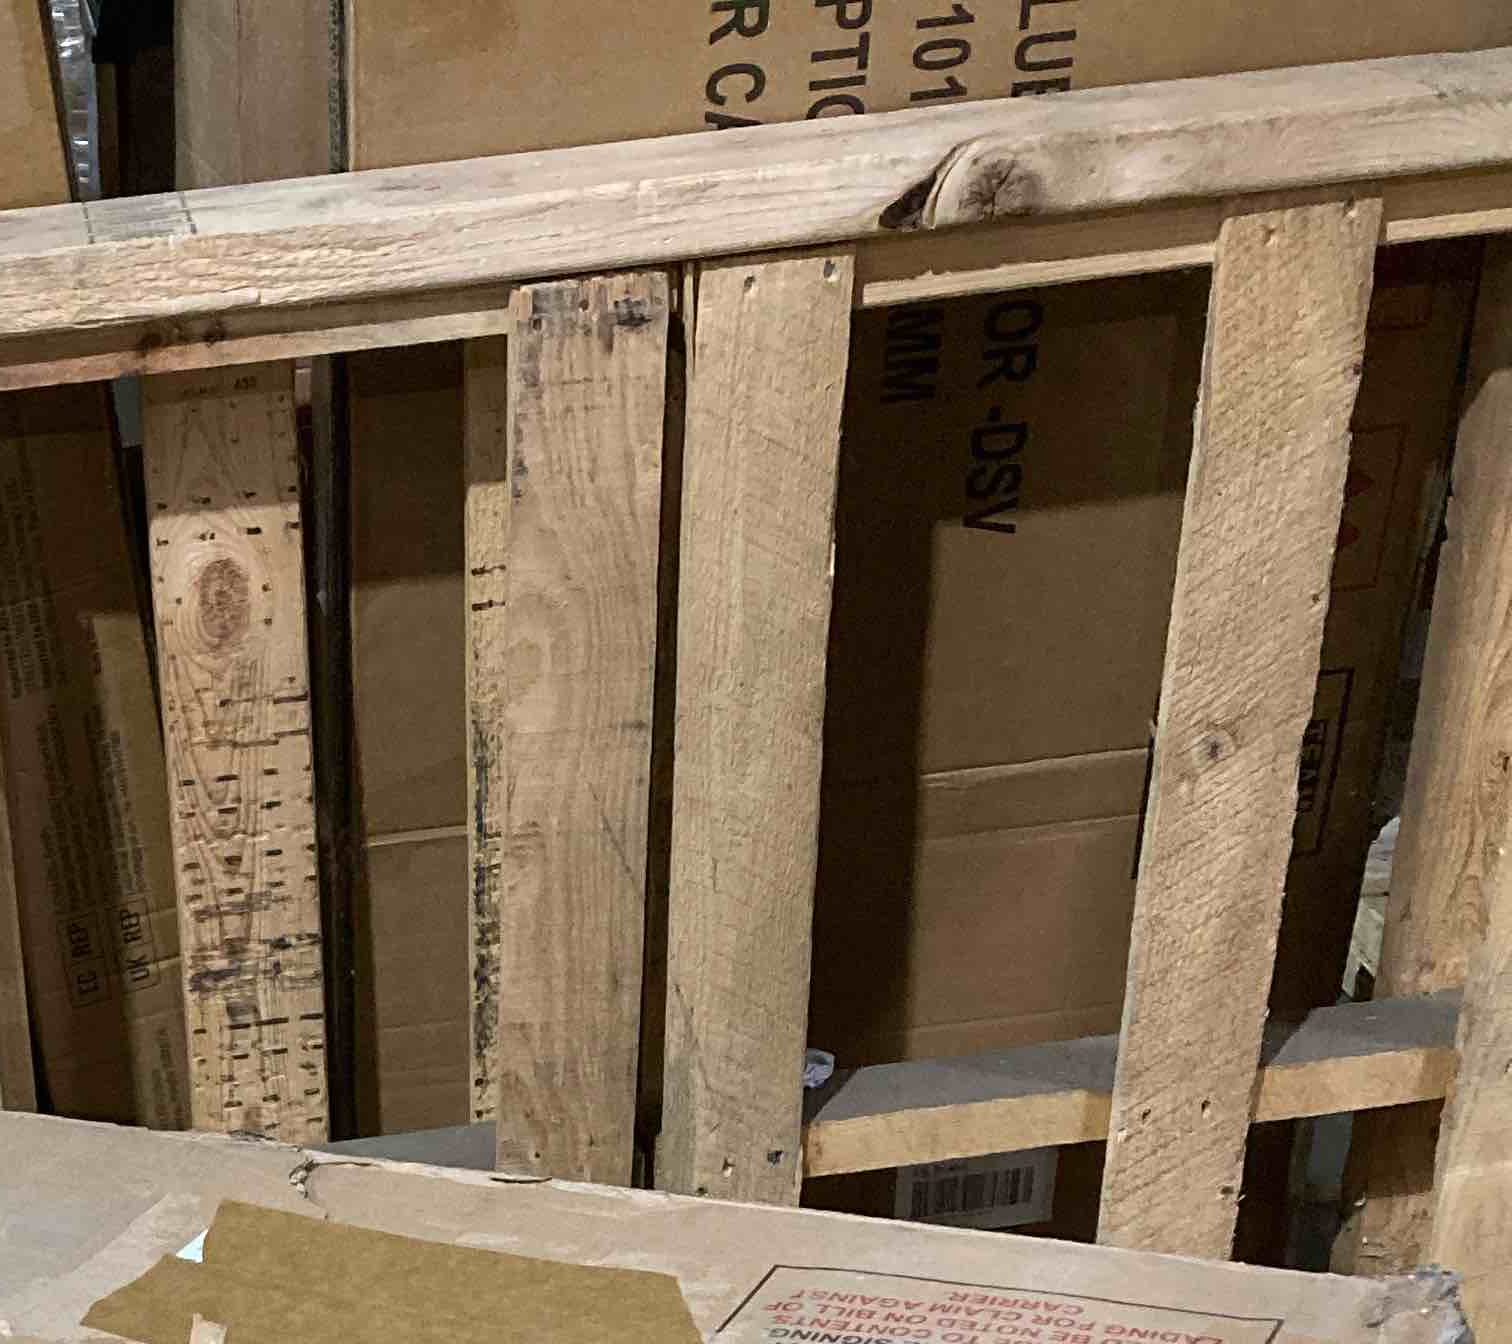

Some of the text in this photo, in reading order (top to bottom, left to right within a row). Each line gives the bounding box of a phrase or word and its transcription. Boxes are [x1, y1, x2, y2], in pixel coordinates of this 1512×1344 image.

[761, 1302, 803, 1313] OF
[790, 1288, 924, 1311] AGAINST
[948, 1291, 1083, 1316] CARRIER
[816, 1304, 876, 1320] BILL
[878, 1312, 927, 1326] ON
[924, 1302, 1023, 1322] CLAIM
[771, 1313, 933, 1340] CONTENTS
[936, 1318, 1042, 1339] NOTED
[1030, 1313, 1095, 1332] FOR
